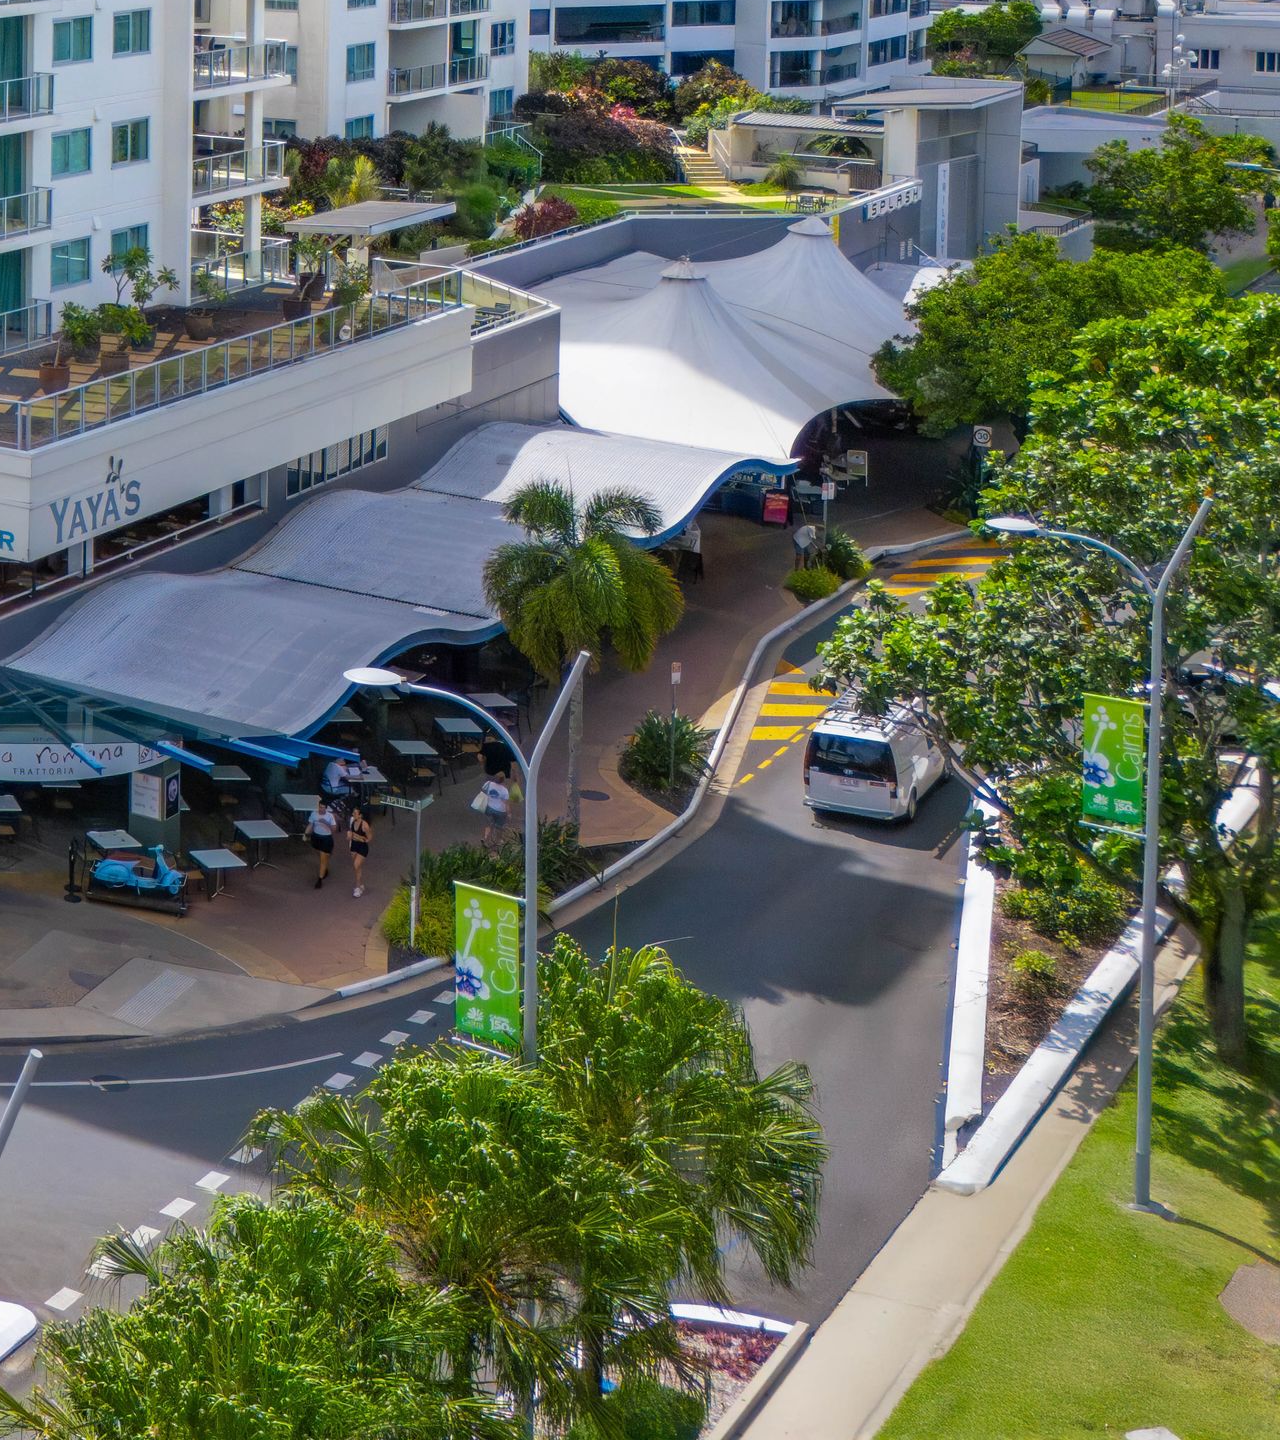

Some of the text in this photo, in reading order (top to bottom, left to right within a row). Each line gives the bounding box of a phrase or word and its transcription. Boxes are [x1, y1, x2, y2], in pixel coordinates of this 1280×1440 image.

[871, 187, 919, 216] SPLASH
[977, 432, 989, 440] 30
[50, 480, 141, 545] YAYA'S
[1115, 713, 1141, 781] Cairns
[13, 767, 74, 776] TRATTORIA
[490, 909, 517, 994] Cairns
